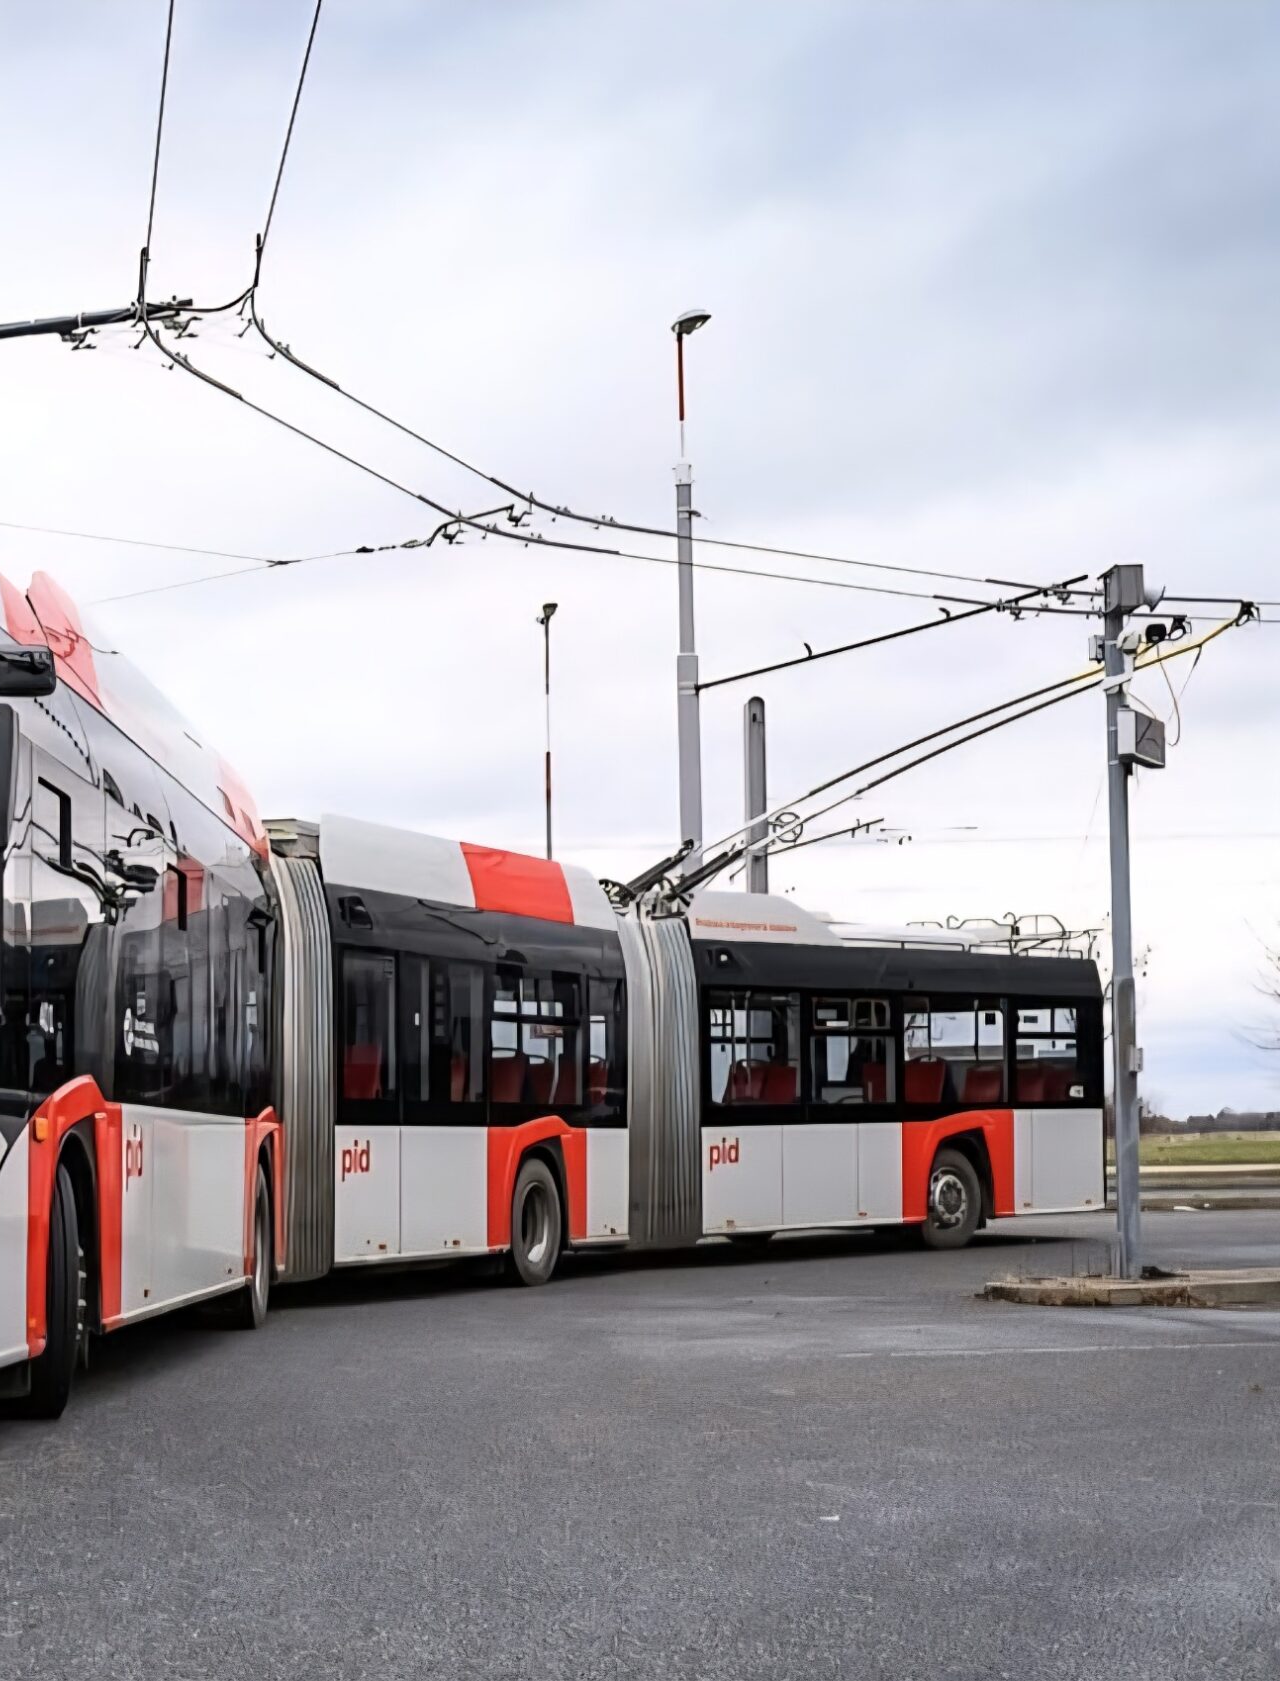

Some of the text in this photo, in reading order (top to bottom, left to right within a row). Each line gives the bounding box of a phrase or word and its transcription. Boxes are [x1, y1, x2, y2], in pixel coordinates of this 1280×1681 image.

[125, 1123, 143, 1192] pid
[342, 1139, 370, 1182] pid
[709, 1137, 739, 1171] pid
